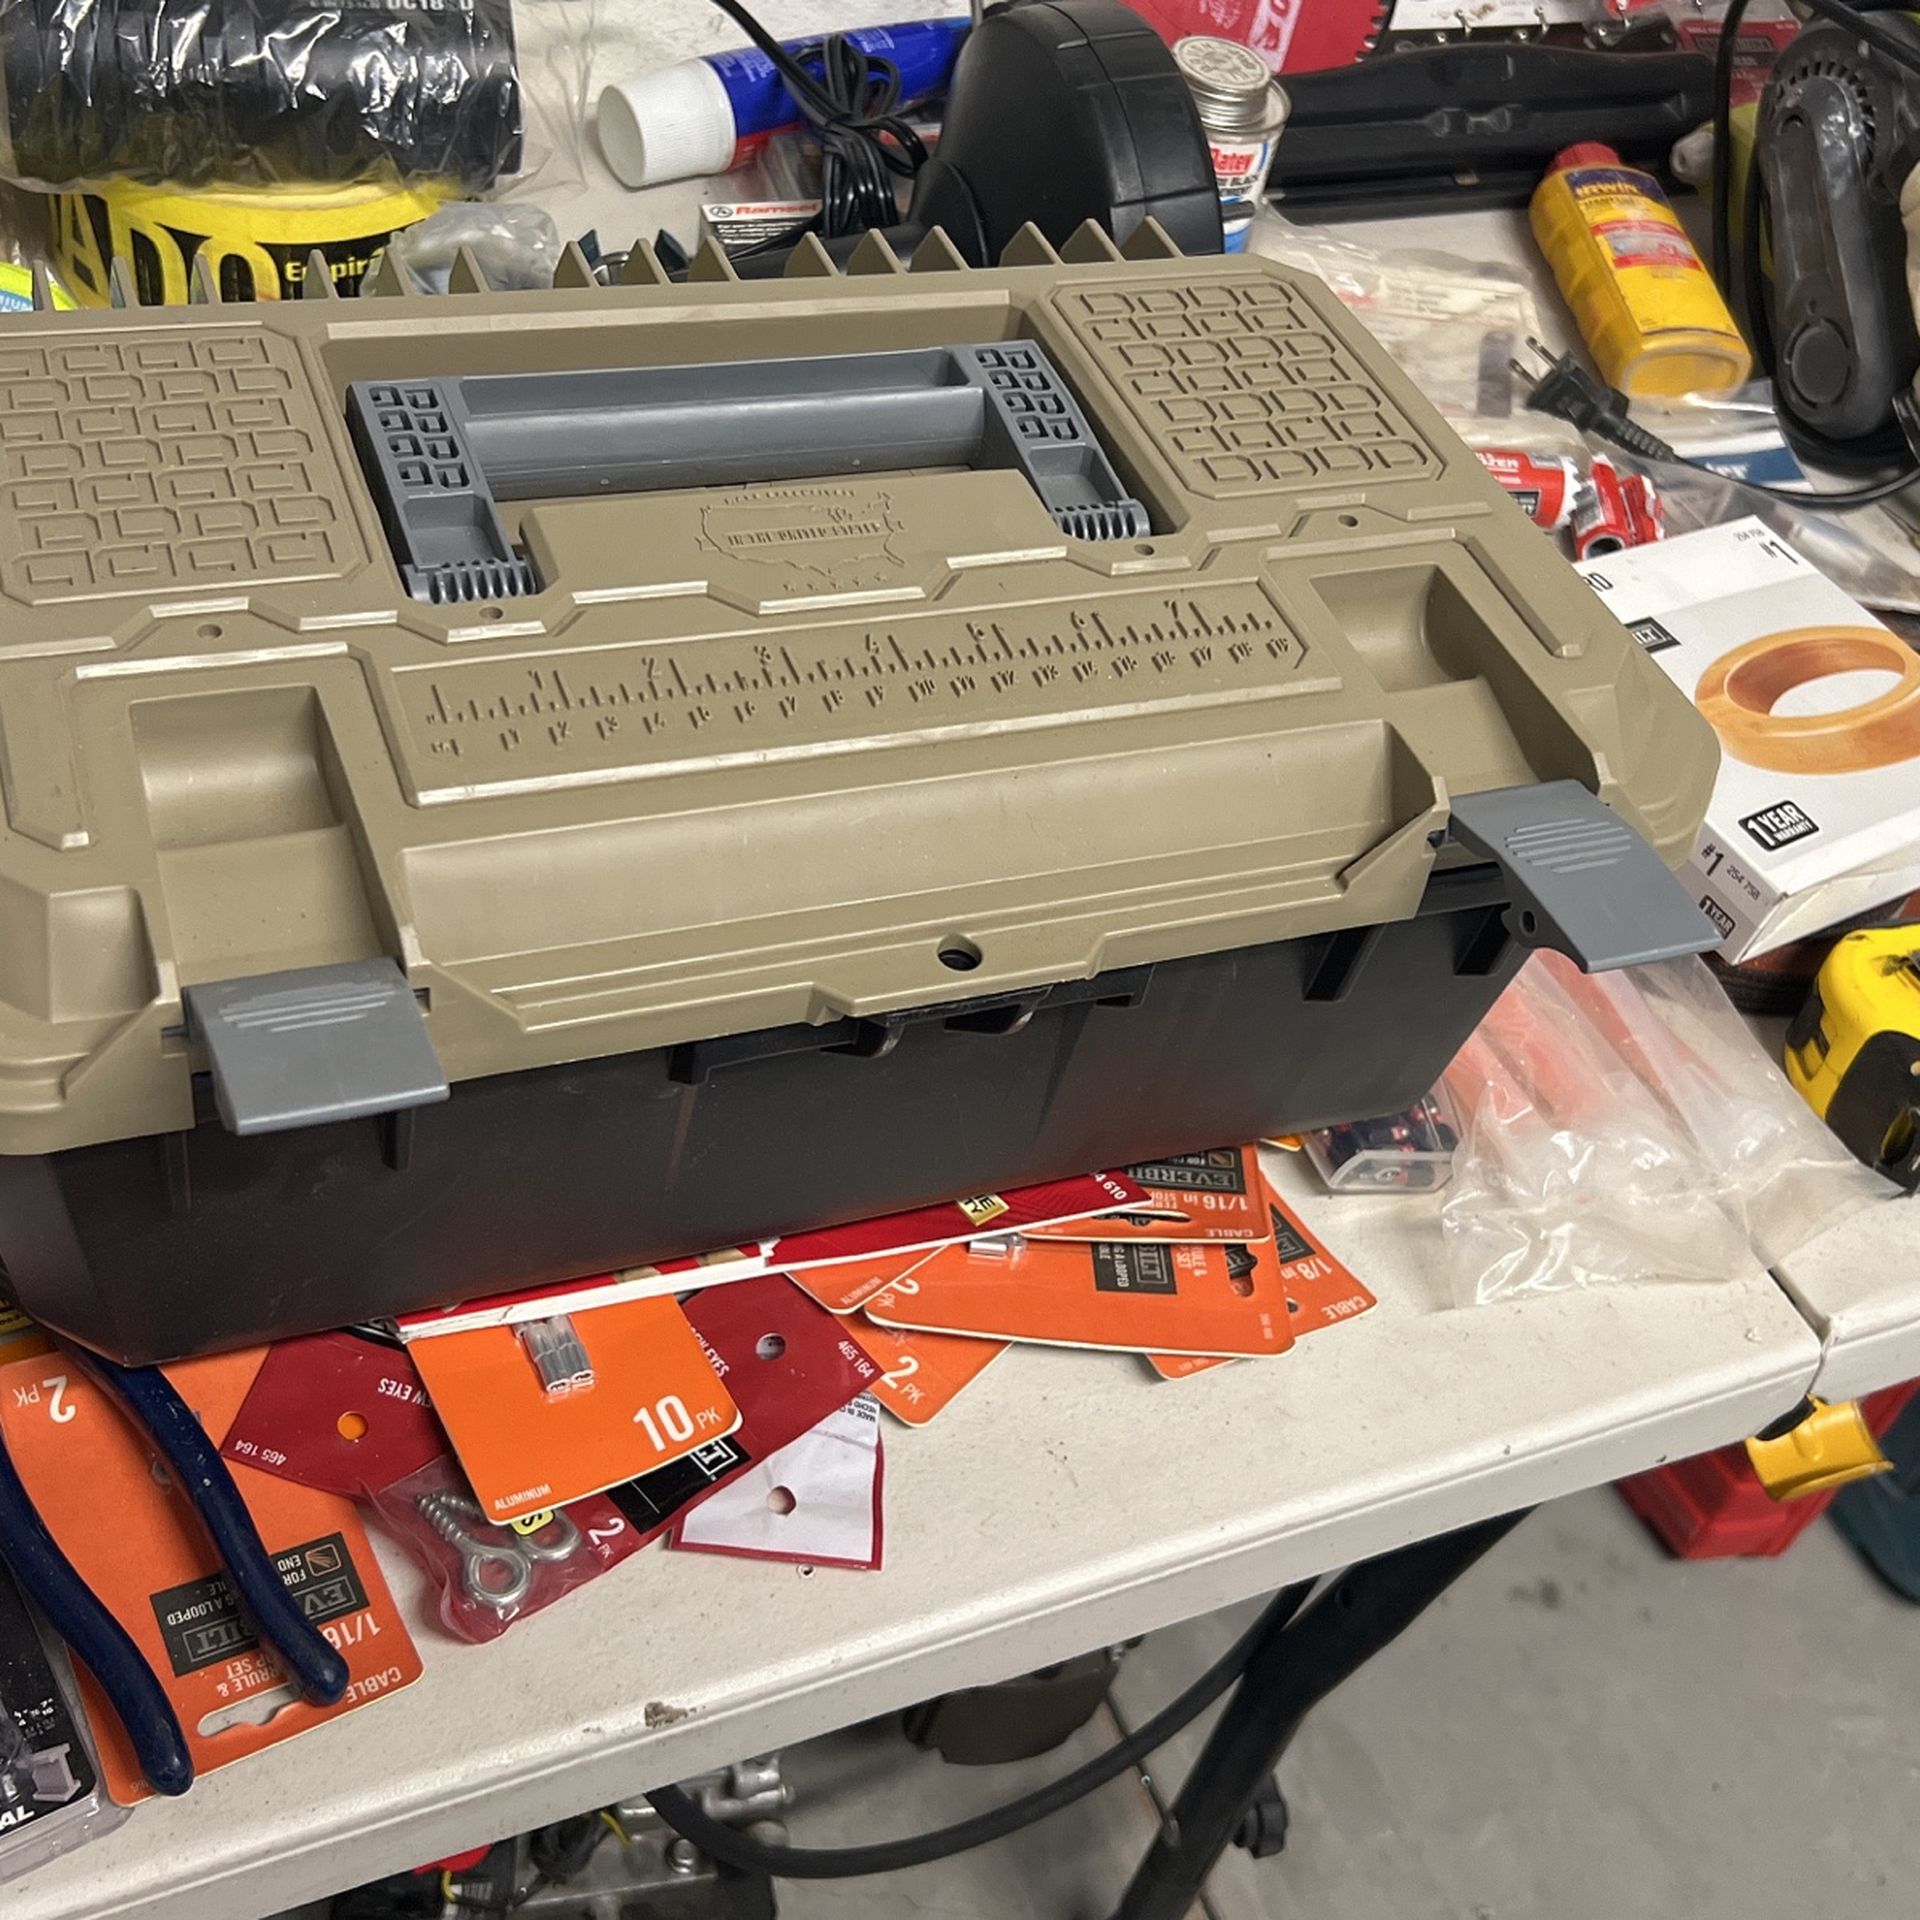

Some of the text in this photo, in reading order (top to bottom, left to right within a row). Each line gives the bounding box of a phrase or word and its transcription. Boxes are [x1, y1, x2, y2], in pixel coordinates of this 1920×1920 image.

[1761, 540, 1799, 565] #1
[642, 657, 661, 679] 2
[754, 645, 772, 666] 3
[1070, 611, 1087, 630] 6
[1164, 600, 1179, 620] 7
[1747, 804, 1805, 847] 1 YEAR
[1773, 820, 1814, 843] WARRANTY
[1701, 843, 1724, 876] #1
[1711, 906, 1733, 935] YEAR
[1102, 1180, 1127, 1200] 610
[1183, 1194, 1249, 1211] 1/16 in
[1206, 1228, 1254, 1238] CABLE
[1297, 1258, 1333, 1282] 1/8
[1321, 1295, 1368, 1320] CABLE
[837, 1340, 875, 1378] 465 164
[377, 1377, 412, 1401] EYES
[880, 1356, 926, 1404] 2 PK
[12, 1374, 76, 1424] 2 PK
[632, 1395, 722, 1452] 10 PK
[235, 1438, 287, 1466] 465 164
[494, 1484, 552, 1511] ALUMINUM
[588, 1517, 626, 1559] 2 PK
[277, 1554, 302, 1573] END
[283, 1569, 307, 1586] FOR
[167, 1600, 214, 1626] LOOPED
[226, 1660, 253, 1680] SET
[216, 1682, 229, 1697] &
[347, 1666, 402, 1703] CABLE
